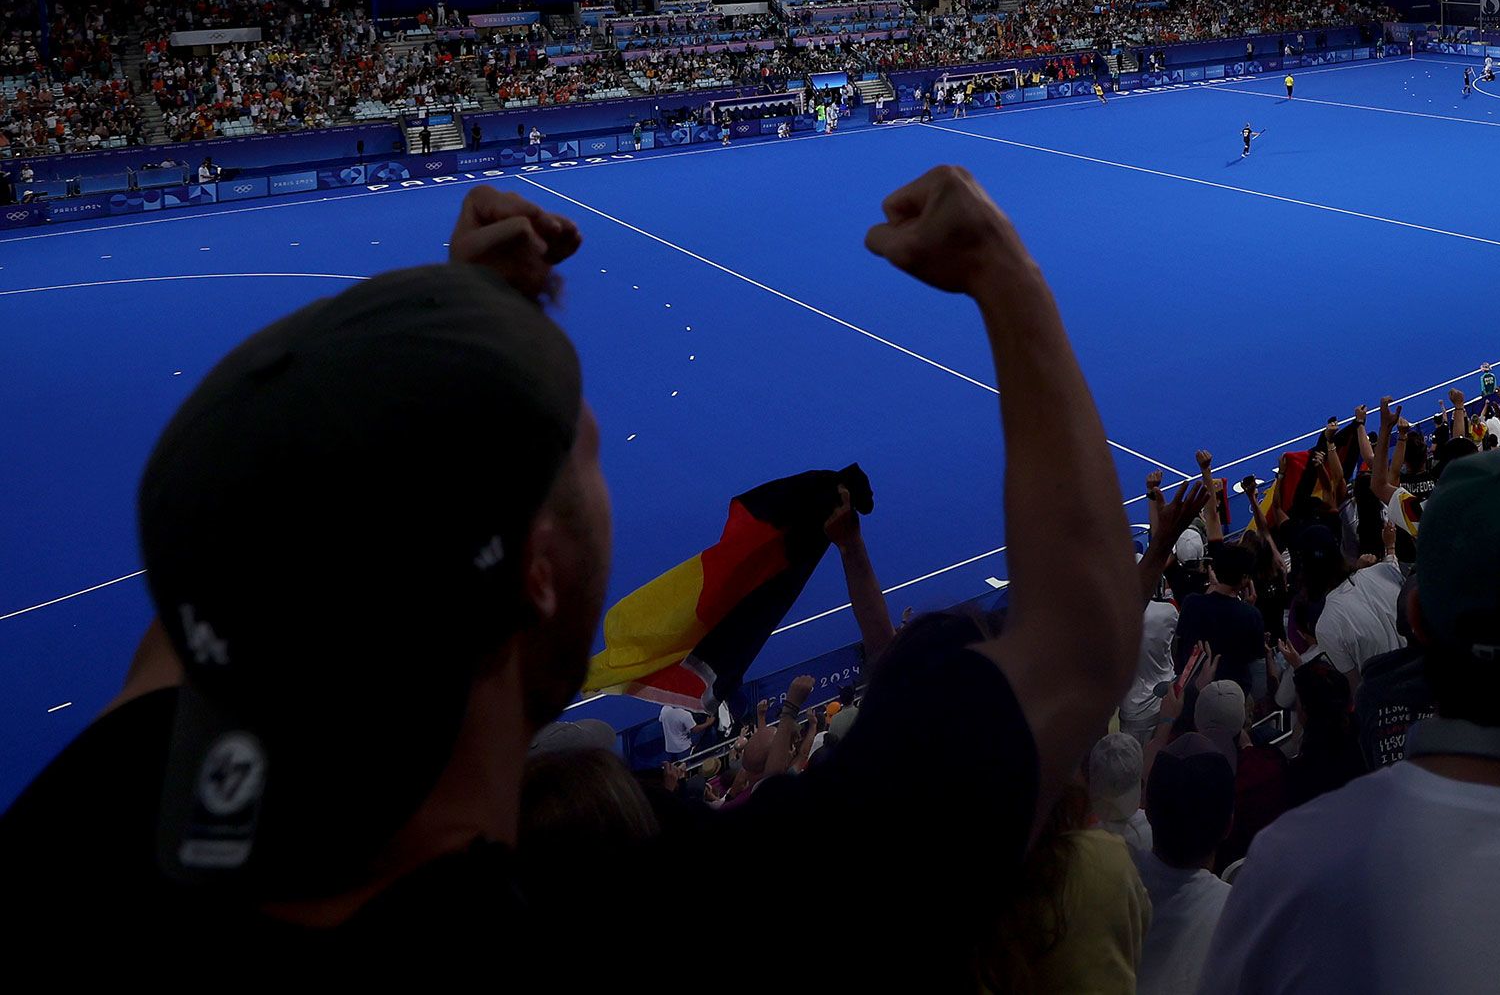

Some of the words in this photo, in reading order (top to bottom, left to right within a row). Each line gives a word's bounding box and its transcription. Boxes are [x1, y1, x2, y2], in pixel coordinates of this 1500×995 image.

[54, 206, 78, 214] PARIS
[80, 204, 102, 212] 2024
[820, 665, 860, 688] 2024
[1385, 713, 1410, 724] LOVE
